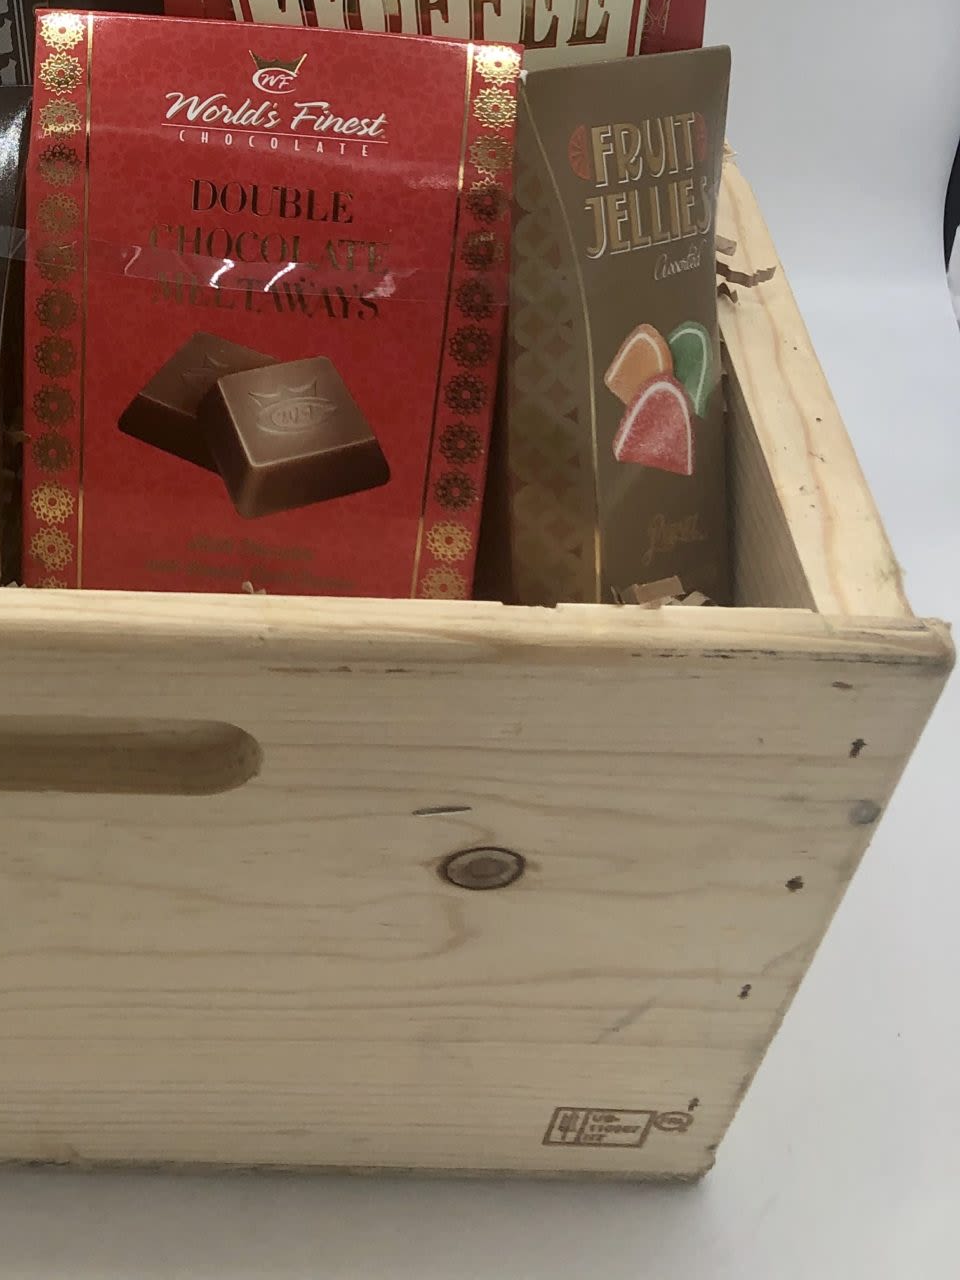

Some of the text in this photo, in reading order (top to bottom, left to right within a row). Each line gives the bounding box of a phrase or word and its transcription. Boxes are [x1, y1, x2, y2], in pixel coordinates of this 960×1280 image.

[164, 91, 387, 138] World's Finest
[178, 129, 370, 157] CHOCOLATE
[590, 111, 696, 188] FRUIT
[190, 177, 354, 224] DOUBLE
[584, 175, 713, 260] JELLIES
[148, 223, 391, 274] CHOCOLATE
